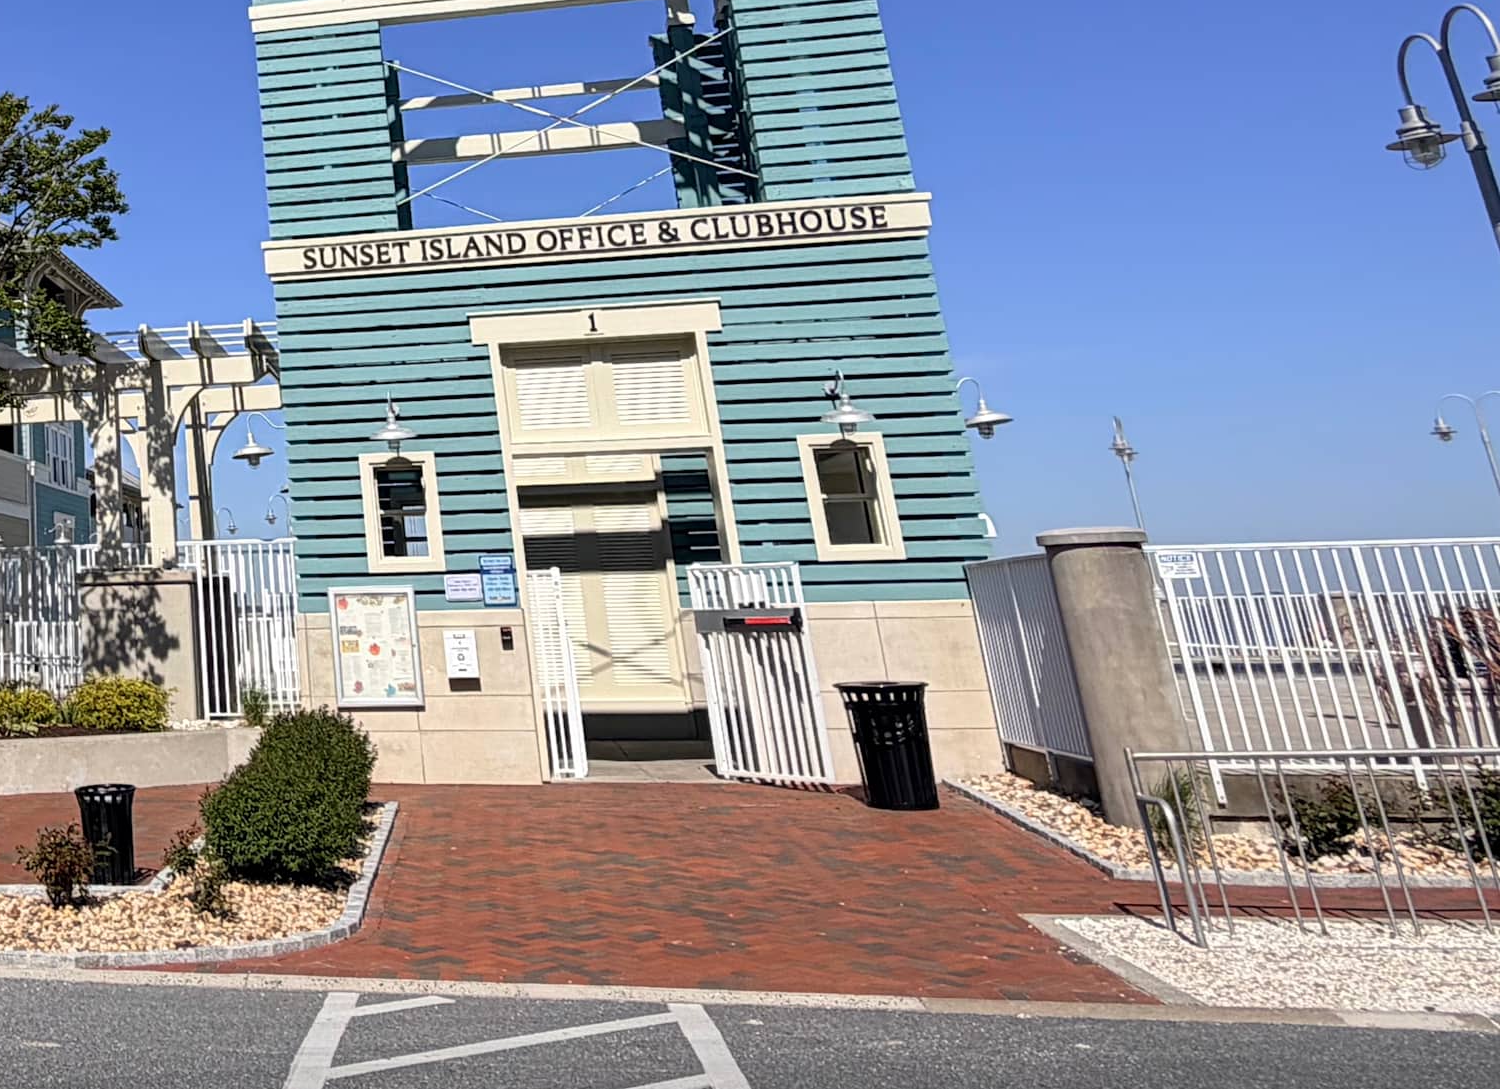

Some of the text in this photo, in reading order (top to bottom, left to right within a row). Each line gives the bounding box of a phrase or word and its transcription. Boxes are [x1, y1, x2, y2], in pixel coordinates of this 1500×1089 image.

[303, 206, 888, 269] SUNSET ISLAND OFFICE & CLUBHOUSE
[587, 311, 598, 332] 1
